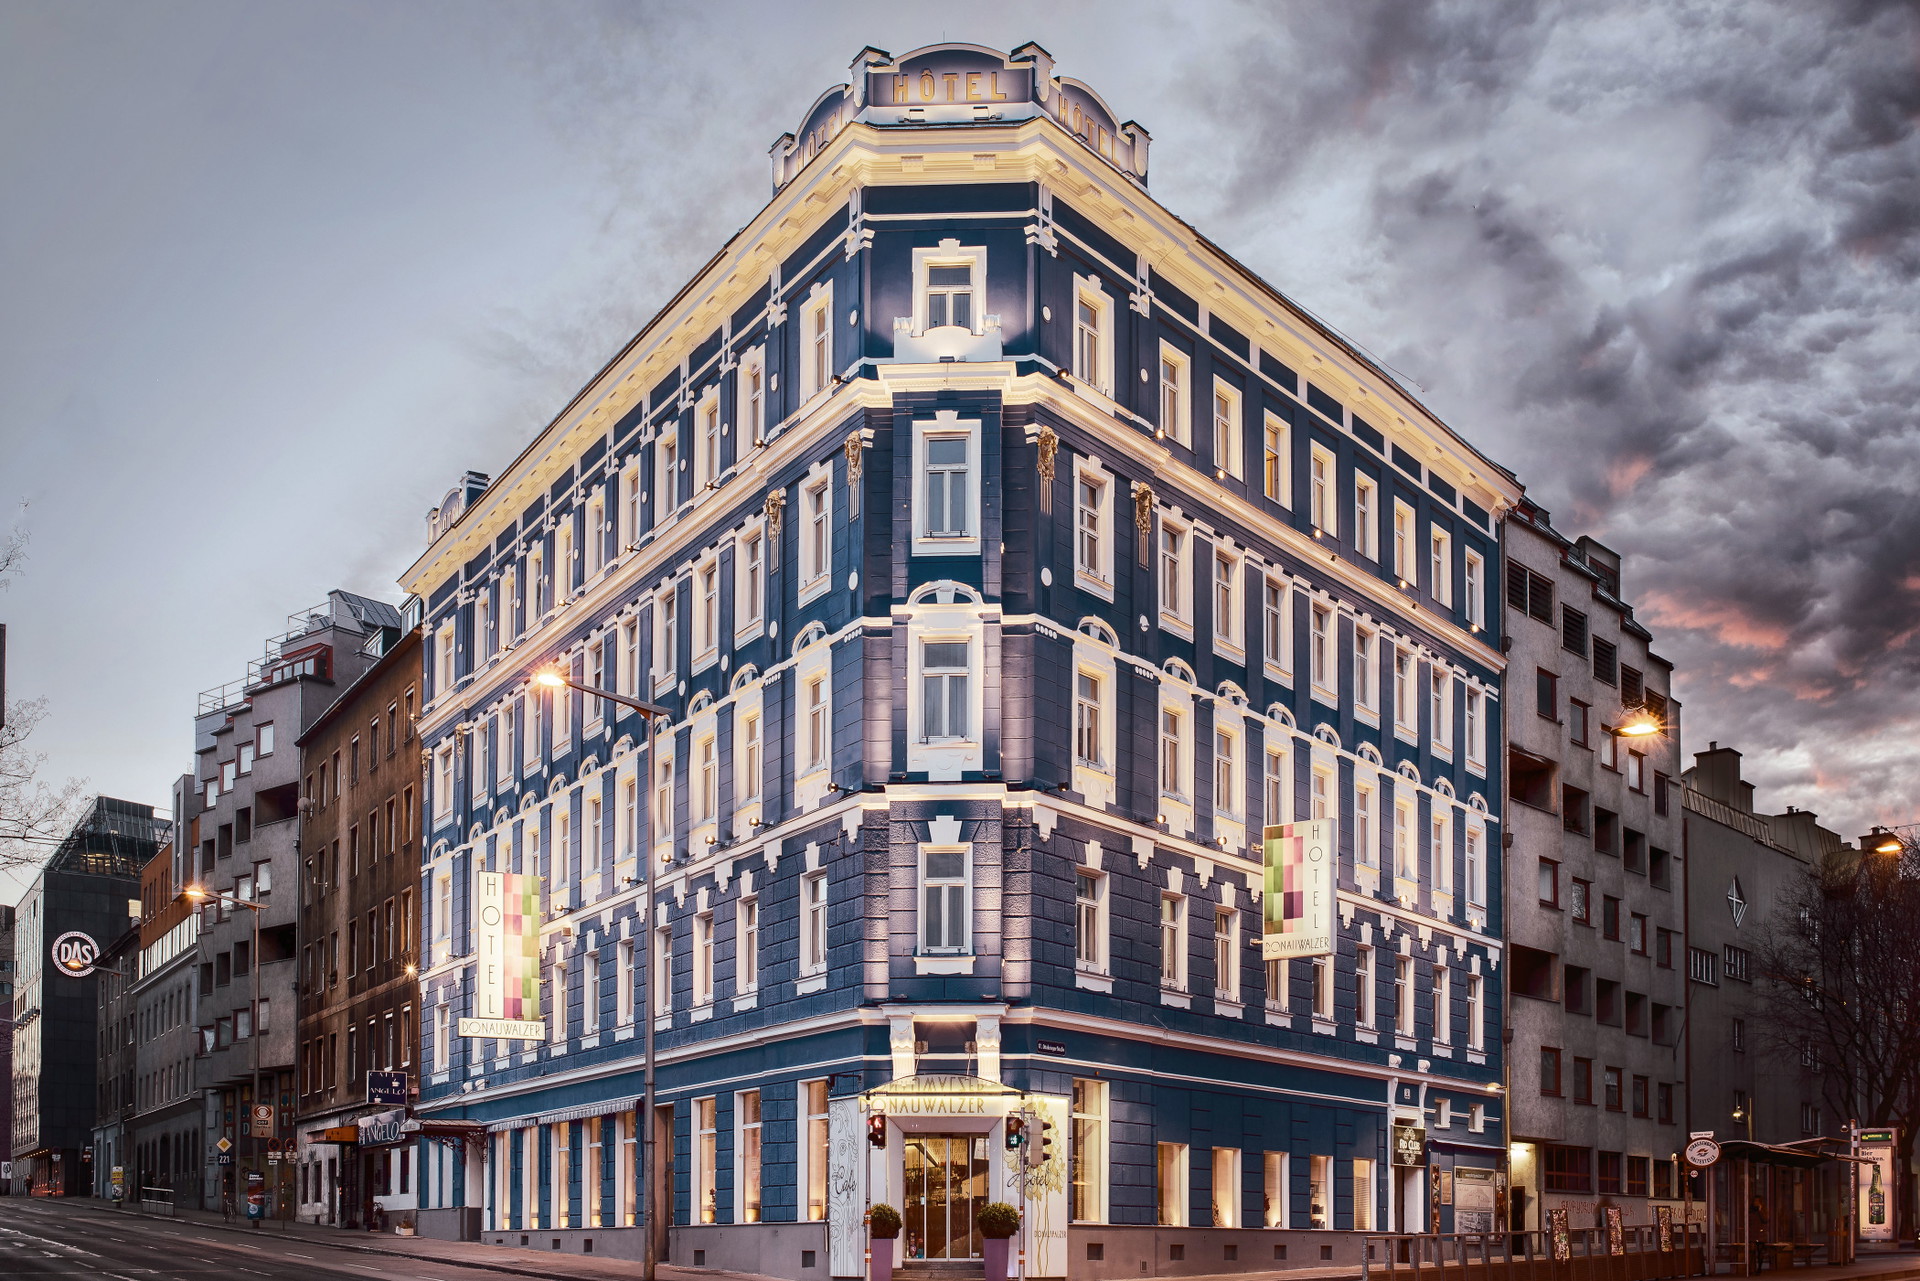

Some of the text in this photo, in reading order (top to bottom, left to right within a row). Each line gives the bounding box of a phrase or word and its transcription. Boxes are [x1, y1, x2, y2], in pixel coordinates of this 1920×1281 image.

[892, 68, 1007, 103] HÔTEL
[1308, 824, 1323, 929] HOTEL
[60, 941, 93, 965] DAS
[481, 876, 501, 1014] HOTEL
[462, 1020, 541, 1037] DONAUWALZER
[859, 1097, 985, 1114] DONAUWALZER
[366, 1121, 399, 1143] ANGELO
[219, 1155, 230, 1164] 221
